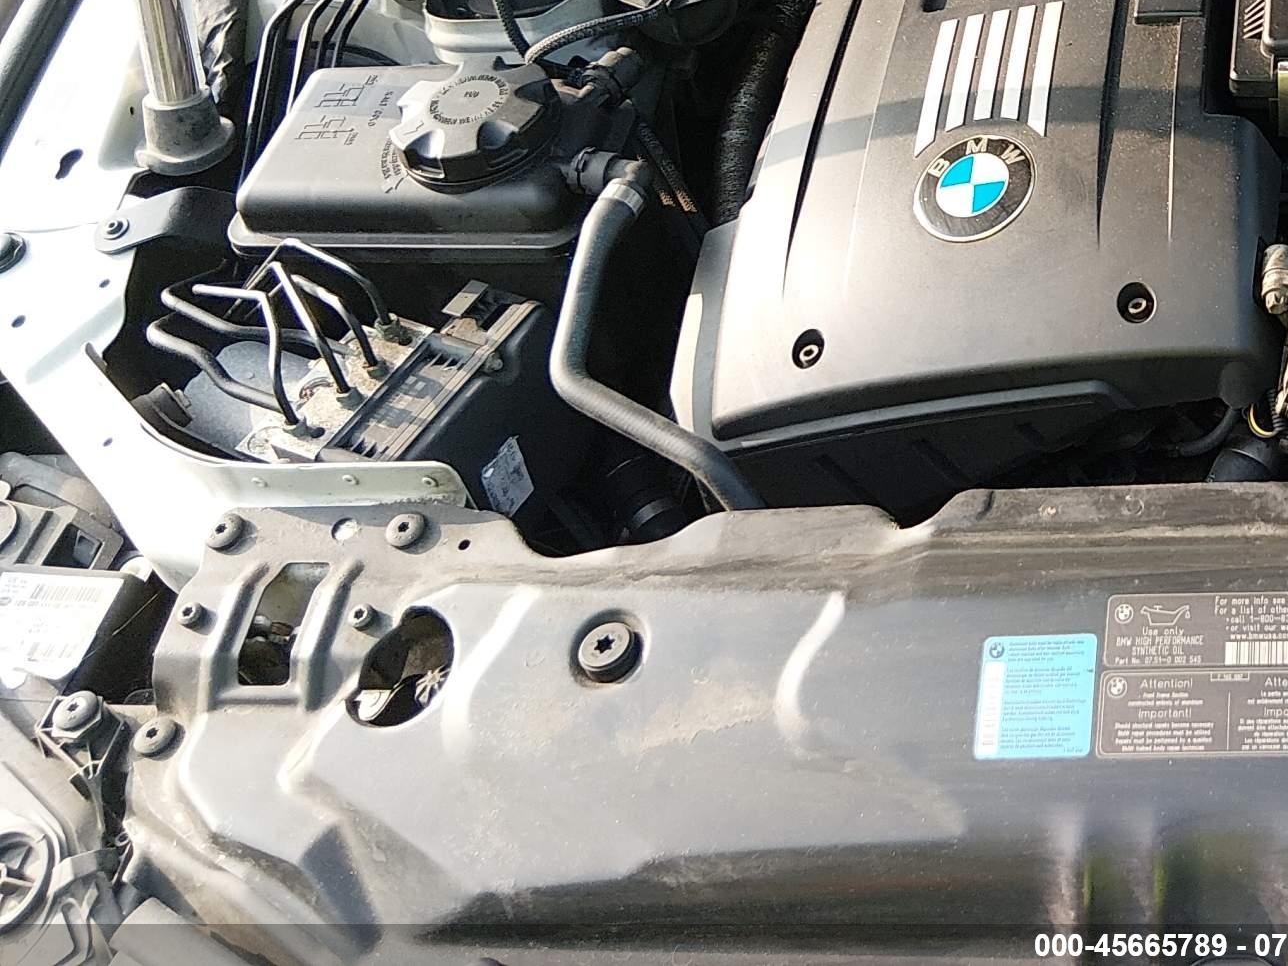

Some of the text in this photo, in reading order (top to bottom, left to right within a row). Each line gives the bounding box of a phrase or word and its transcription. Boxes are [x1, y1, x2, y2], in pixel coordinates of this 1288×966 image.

[928, 138, 1026, 177] BMW
[1215, 596, 1227, 605] For
[1254, 596, 1268, 605] info
[1215, 605, 1227, 615] For
[1232, 607, 1236, 615] a
[1240, 605, 1253, 615] list
[1258, 605, 1266, 614] of
[1142, 627, 1184, 635] Use only
[1243, 623, 1260, 631] visit
[1116, 635, 1204, 646] BMW HIGH PERFORMANCE
[1132, 646, 1184, 655] SYNTHETIC OIL
[1115, 656, 1128, 664] Part
[1140, 678, 1192, 689] Attention!
[1138, 708, 1191, 719] Important!
